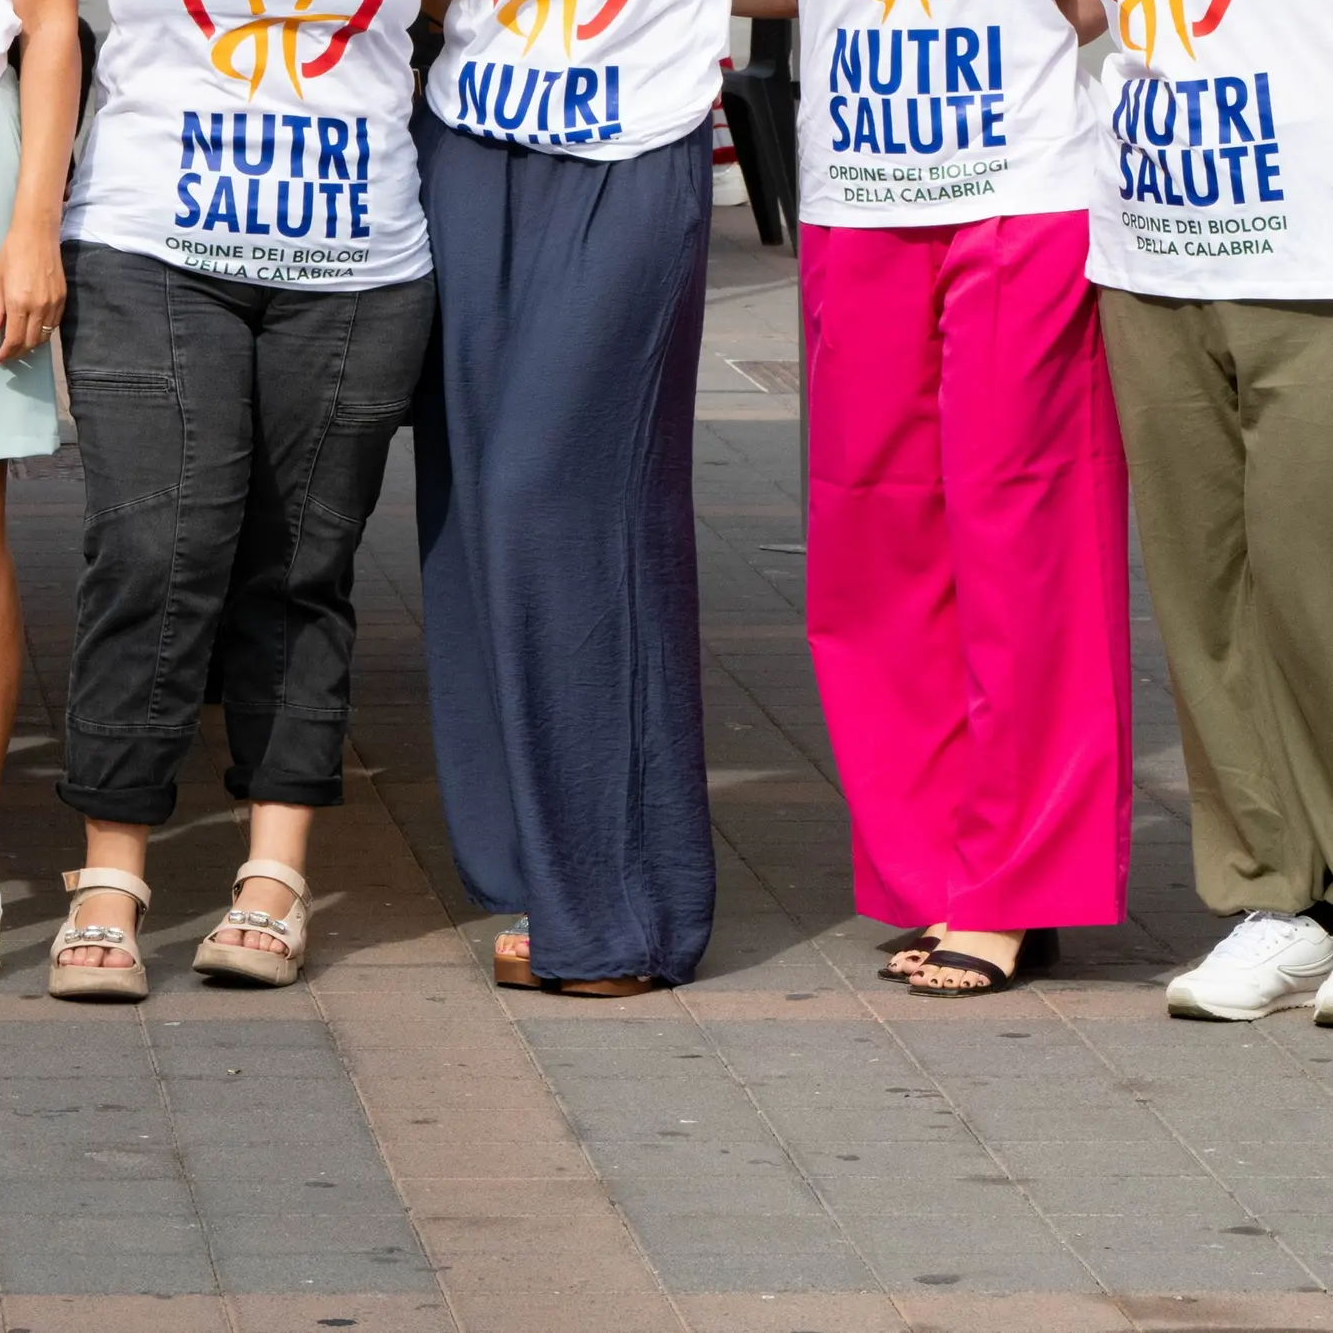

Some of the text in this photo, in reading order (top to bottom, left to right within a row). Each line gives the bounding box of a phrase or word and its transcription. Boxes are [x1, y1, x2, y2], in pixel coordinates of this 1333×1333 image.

[829, 25, 1003, 96] NUTRI
[457, 60, 620, 132] NUTRI
[829, 93, 1007, 155] SALUTE
[1112, 72, 1276, 147] NUTRI
[180, 110, 372, 181] NUTRI
[829, 158, 1008, 181] ORDINE DEI BIOLOGI
[1119, 142, 1285, 207] SALUTE
[174, 171, 372, 239] SALUTE
[844, 179, 996, 202] DELLA CALABRIA
[165, 237, 369, 264] ORDINE DEI BIOLOGI
[1122, 211, 1287, 235] ORDINE DEI BIOLOGI
[1136, 235, 1273, 257] DELLA CALABRIA
[184, 257, 354, 281] DELLA CALABRIA
